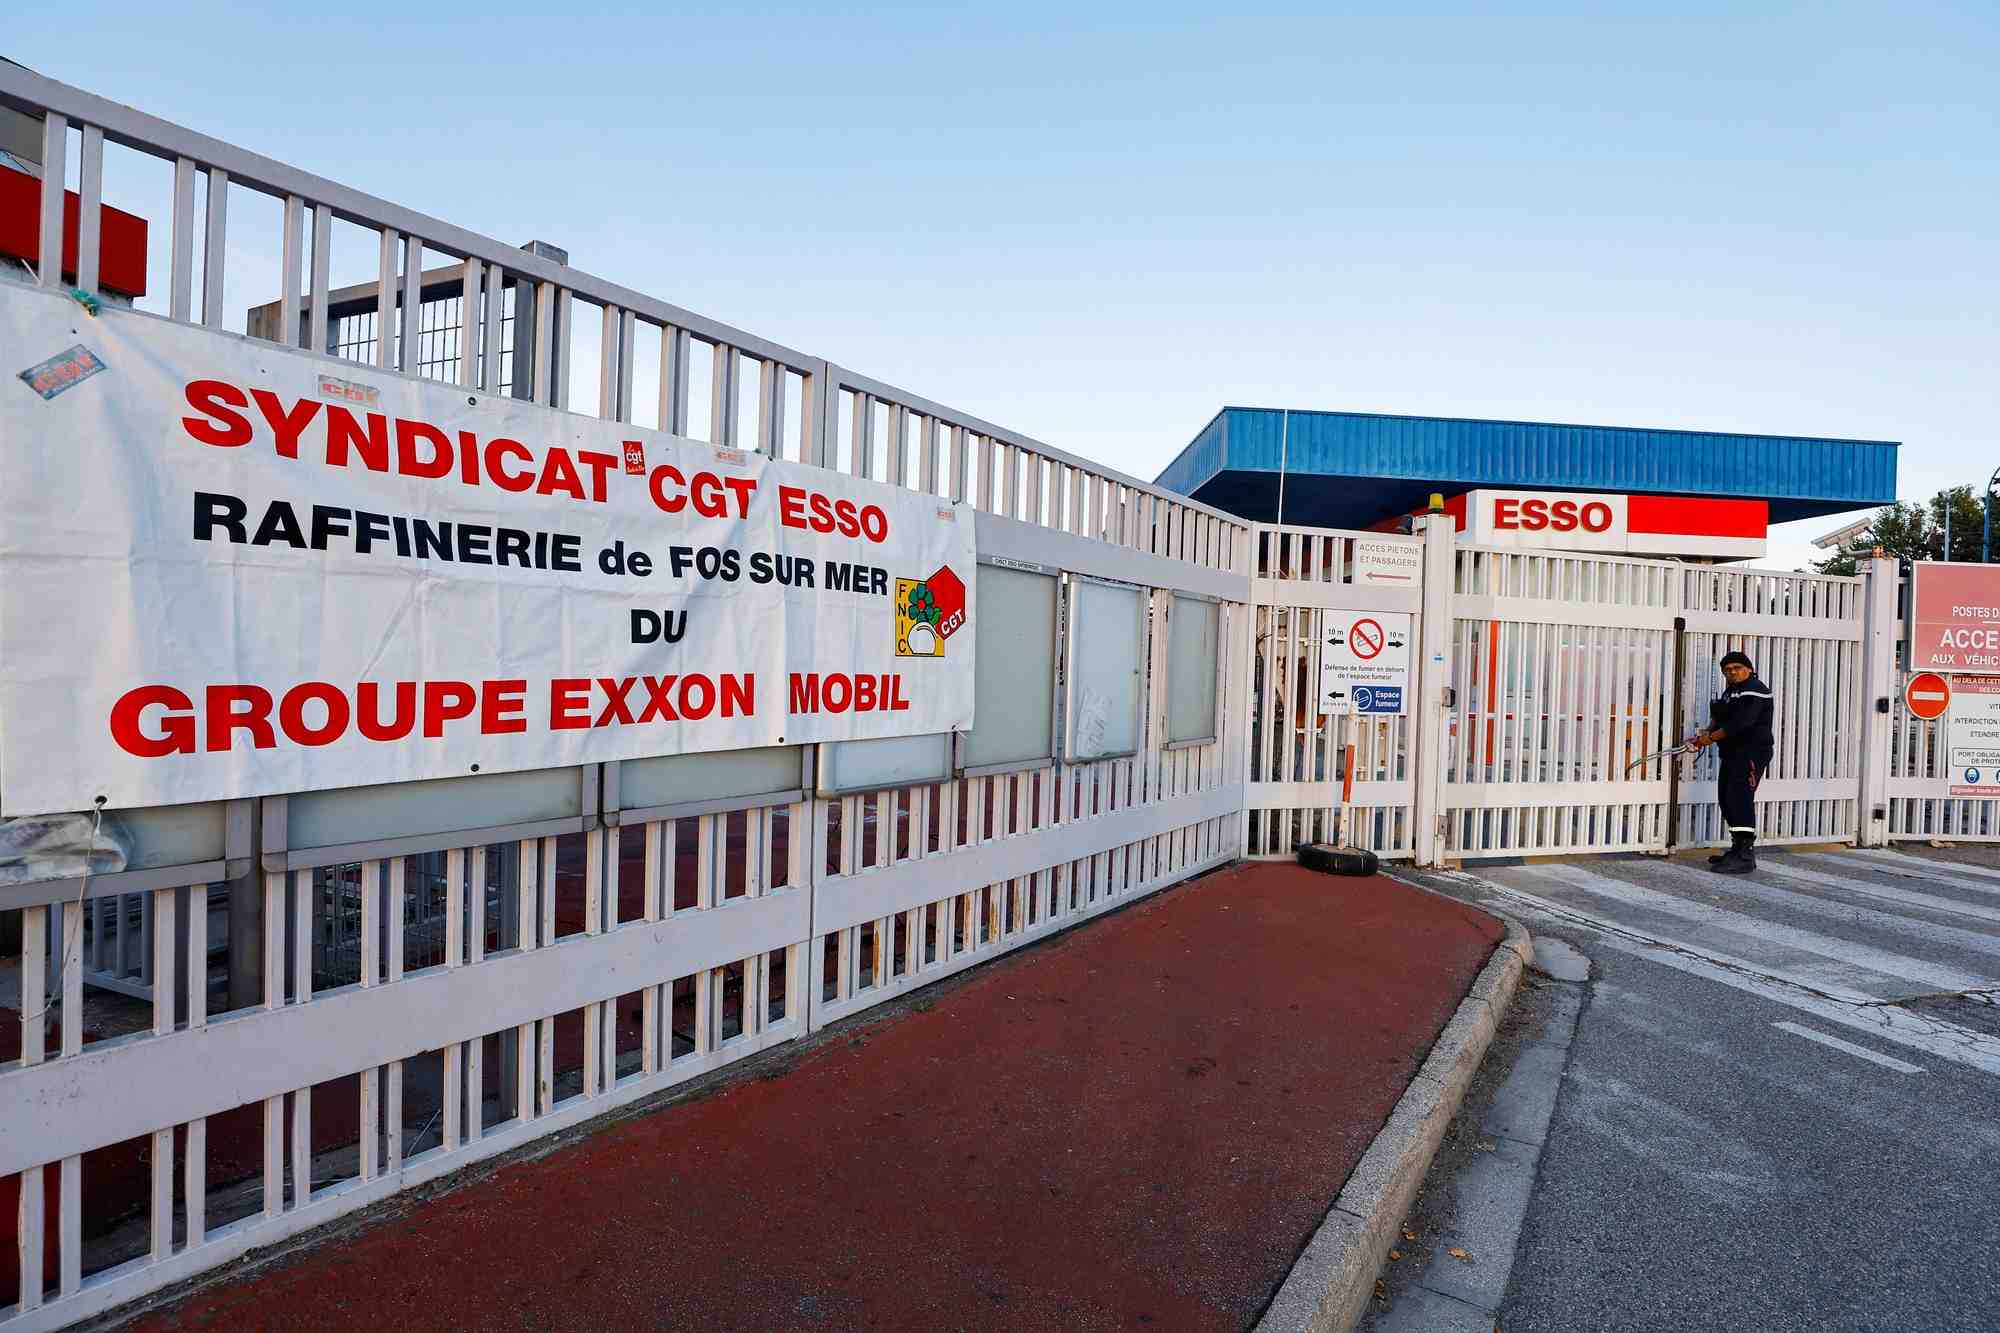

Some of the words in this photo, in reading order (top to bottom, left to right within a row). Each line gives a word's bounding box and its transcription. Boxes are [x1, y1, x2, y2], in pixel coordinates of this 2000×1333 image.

[182, 379, 618, 502] SYNDICAT
[649, 465, 757, 519] CGT
[778, 486, 889, 544] ESSO
[626, 451, 643, 464] cgt
[1494, 498, 1613, 533] ESSO
[193, 492, 581, 572] RAFFINERIE
[599, 541, 653, 577] de
[670, 546, 741, 582] FOS
[750, 553, 815, 588] SUR
[825, 561, 889, 595] MER
[1371, 556, 1417, 567] PASSAGERS
[897, 583, 907, 653] FNIC
[941, 608, 964, 635] CGT
[1952, 606, 1990, 618] POSTES
[630, 609, 688, 644] DU
[1939, 629, 2000, 650] ACCE
[1930, 654, 1955, 665] AUX
[1375, 690, 1400, 699] Espace
[110, 680, 527, 758] GROUPE
[550, 673, 755, 730] EXXON
[790, 673, 909, 714] MOBIL
[1954, 717, 1998, 725] INTERDICTION
